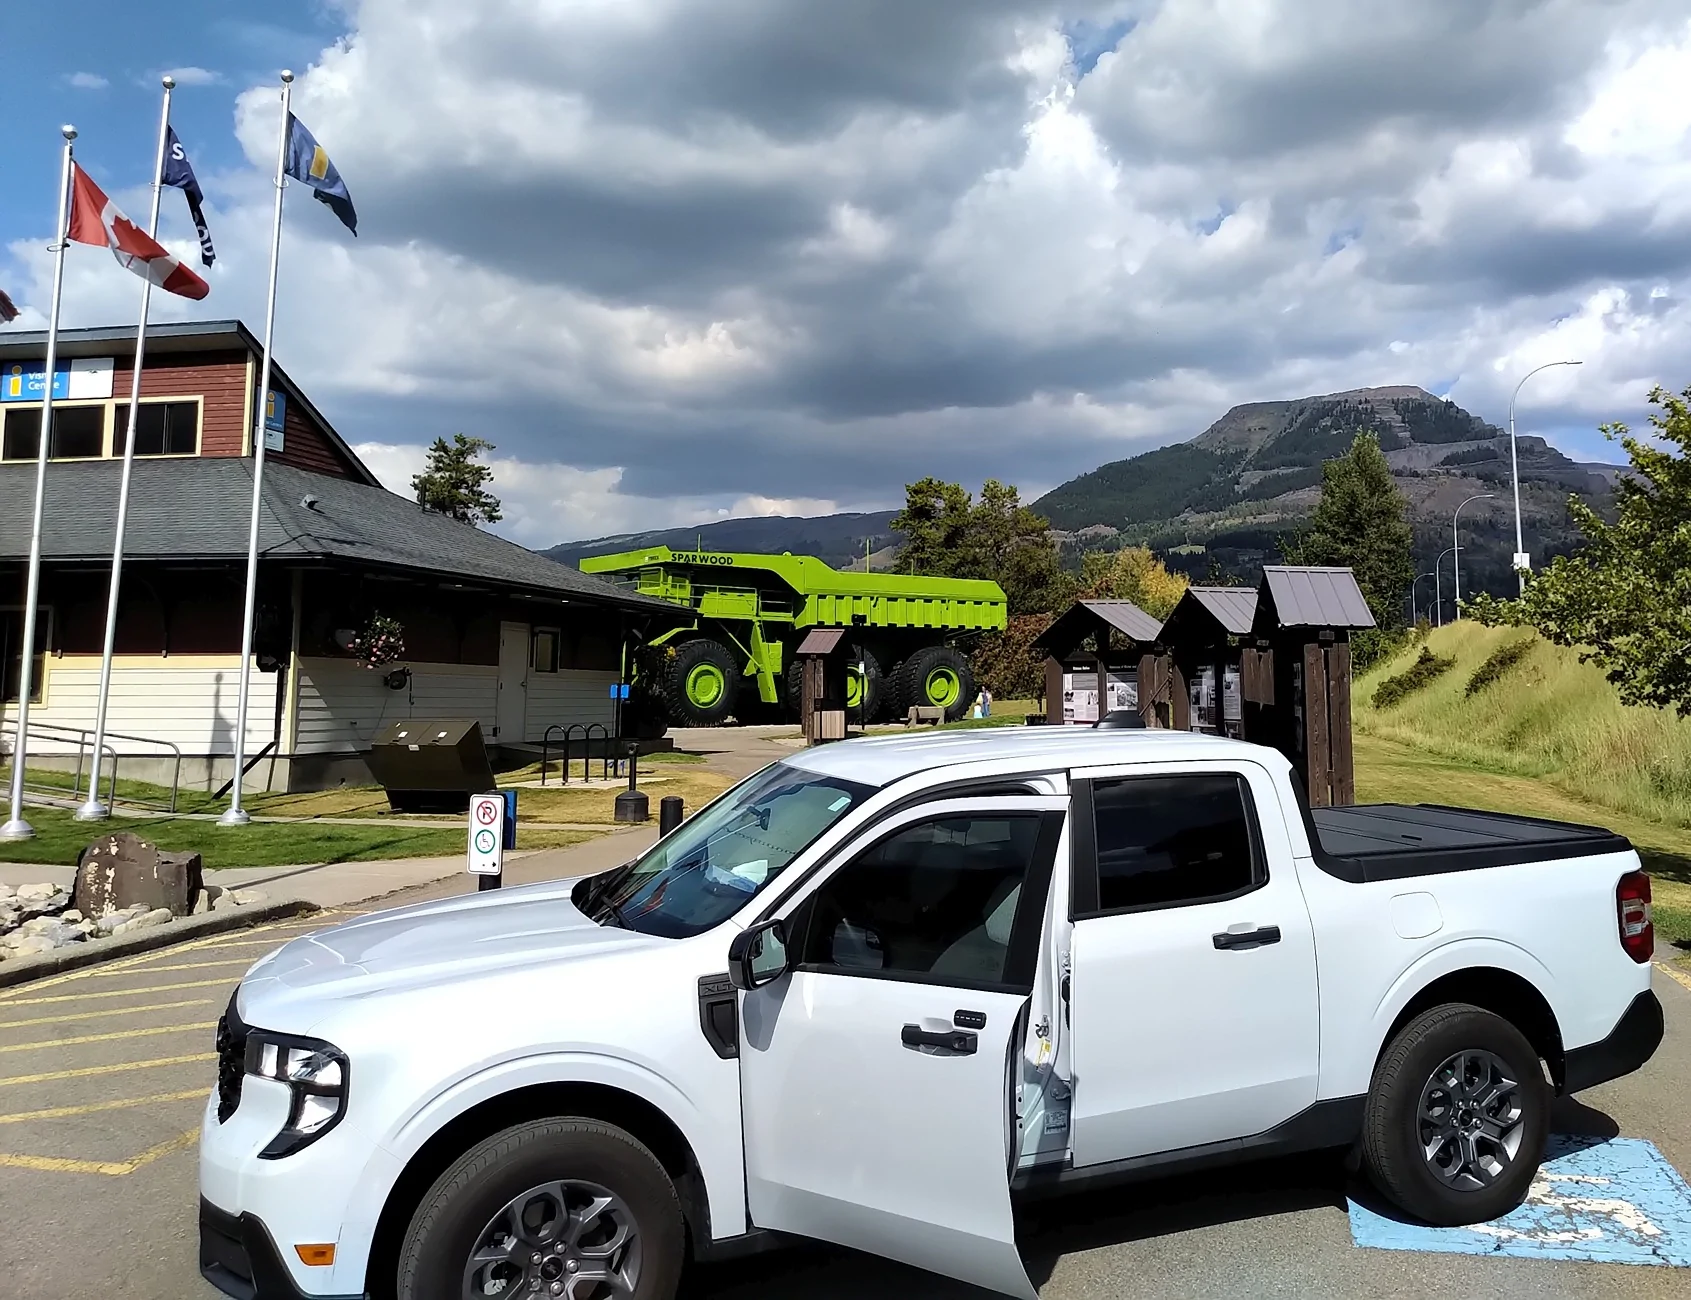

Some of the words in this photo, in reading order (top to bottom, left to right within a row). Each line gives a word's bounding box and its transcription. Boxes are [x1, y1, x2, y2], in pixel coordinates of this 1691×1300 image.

[28, 381, 60, 390] Cene
[671, 553, 734, 565] SPARWOOD
[704, 983, 732, 995] XLT
